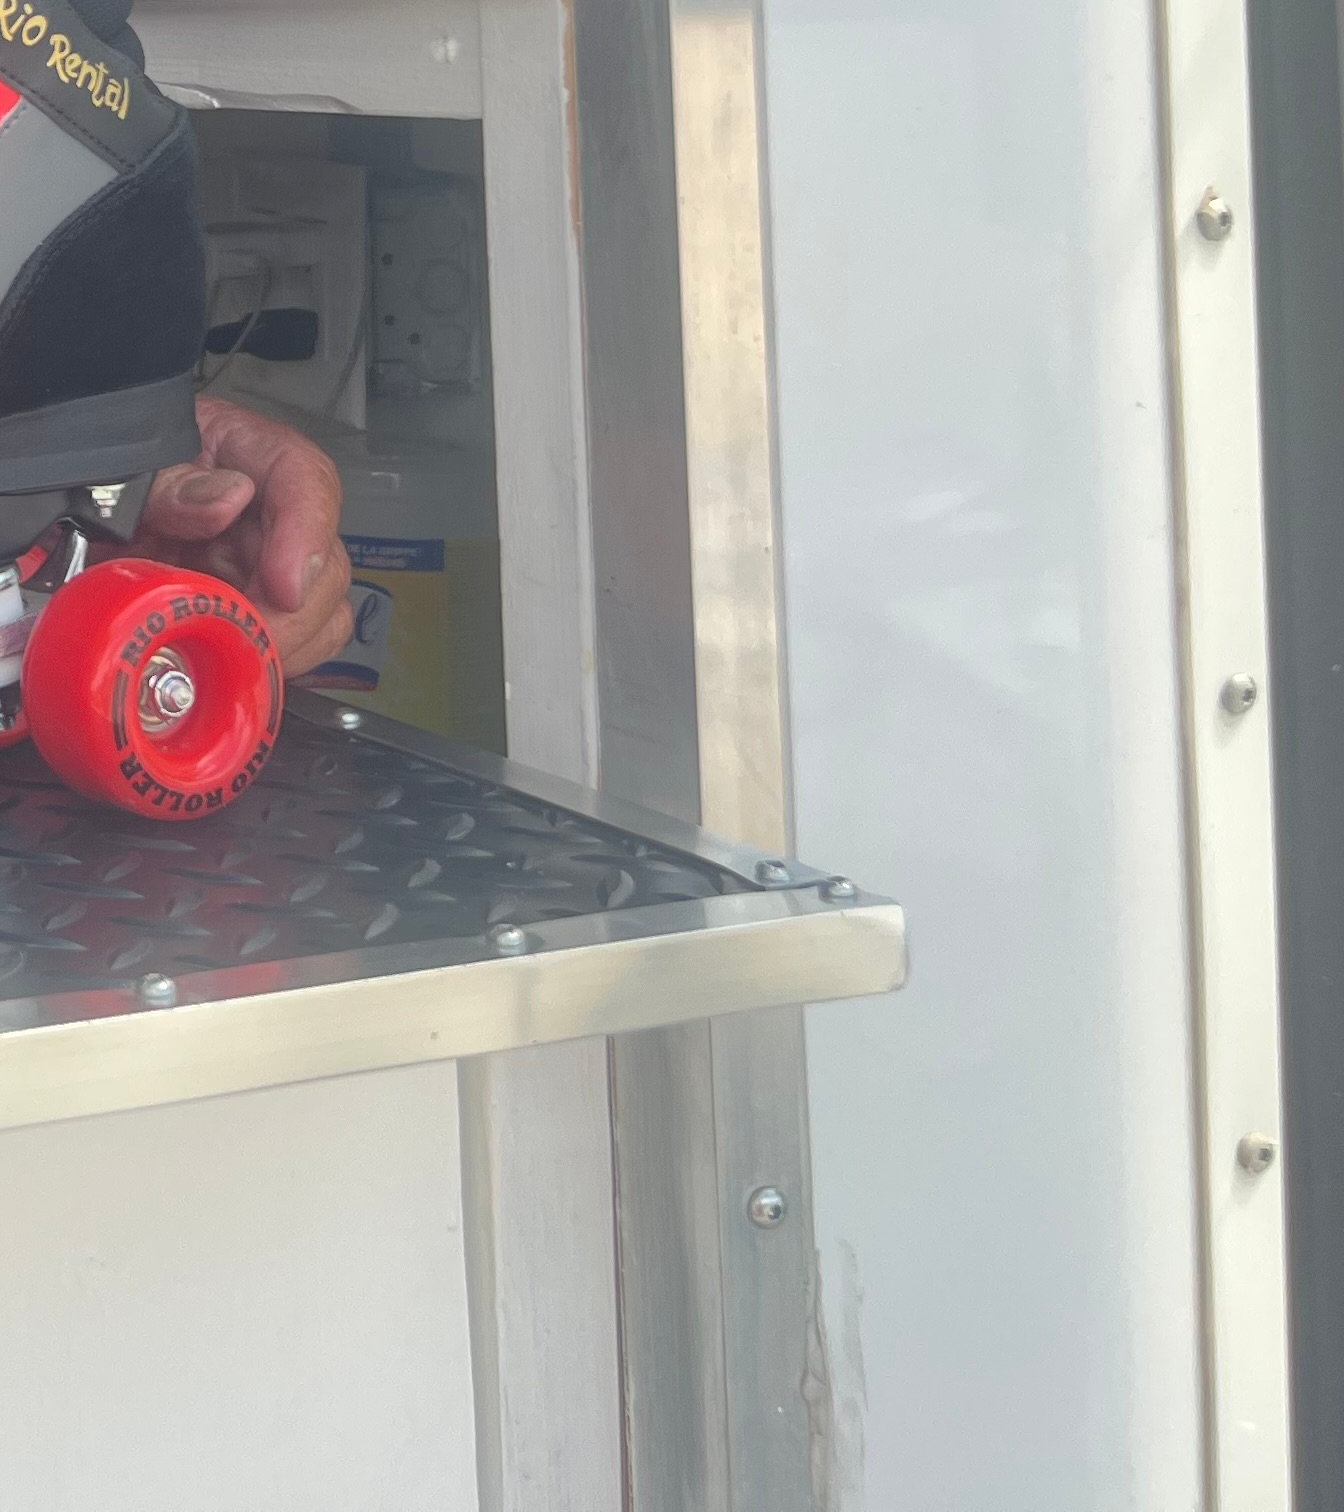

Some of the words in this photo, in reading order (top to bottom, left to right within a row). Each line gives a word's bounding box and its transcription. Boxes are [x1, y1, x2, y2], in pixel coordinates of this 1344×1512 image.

[46, 34, 130, 120] Rental
[122, 610, 165, 669] RIO
[169, 593, 271, 657] ROLLER
[119, 751, 224, 813] ROLLER
